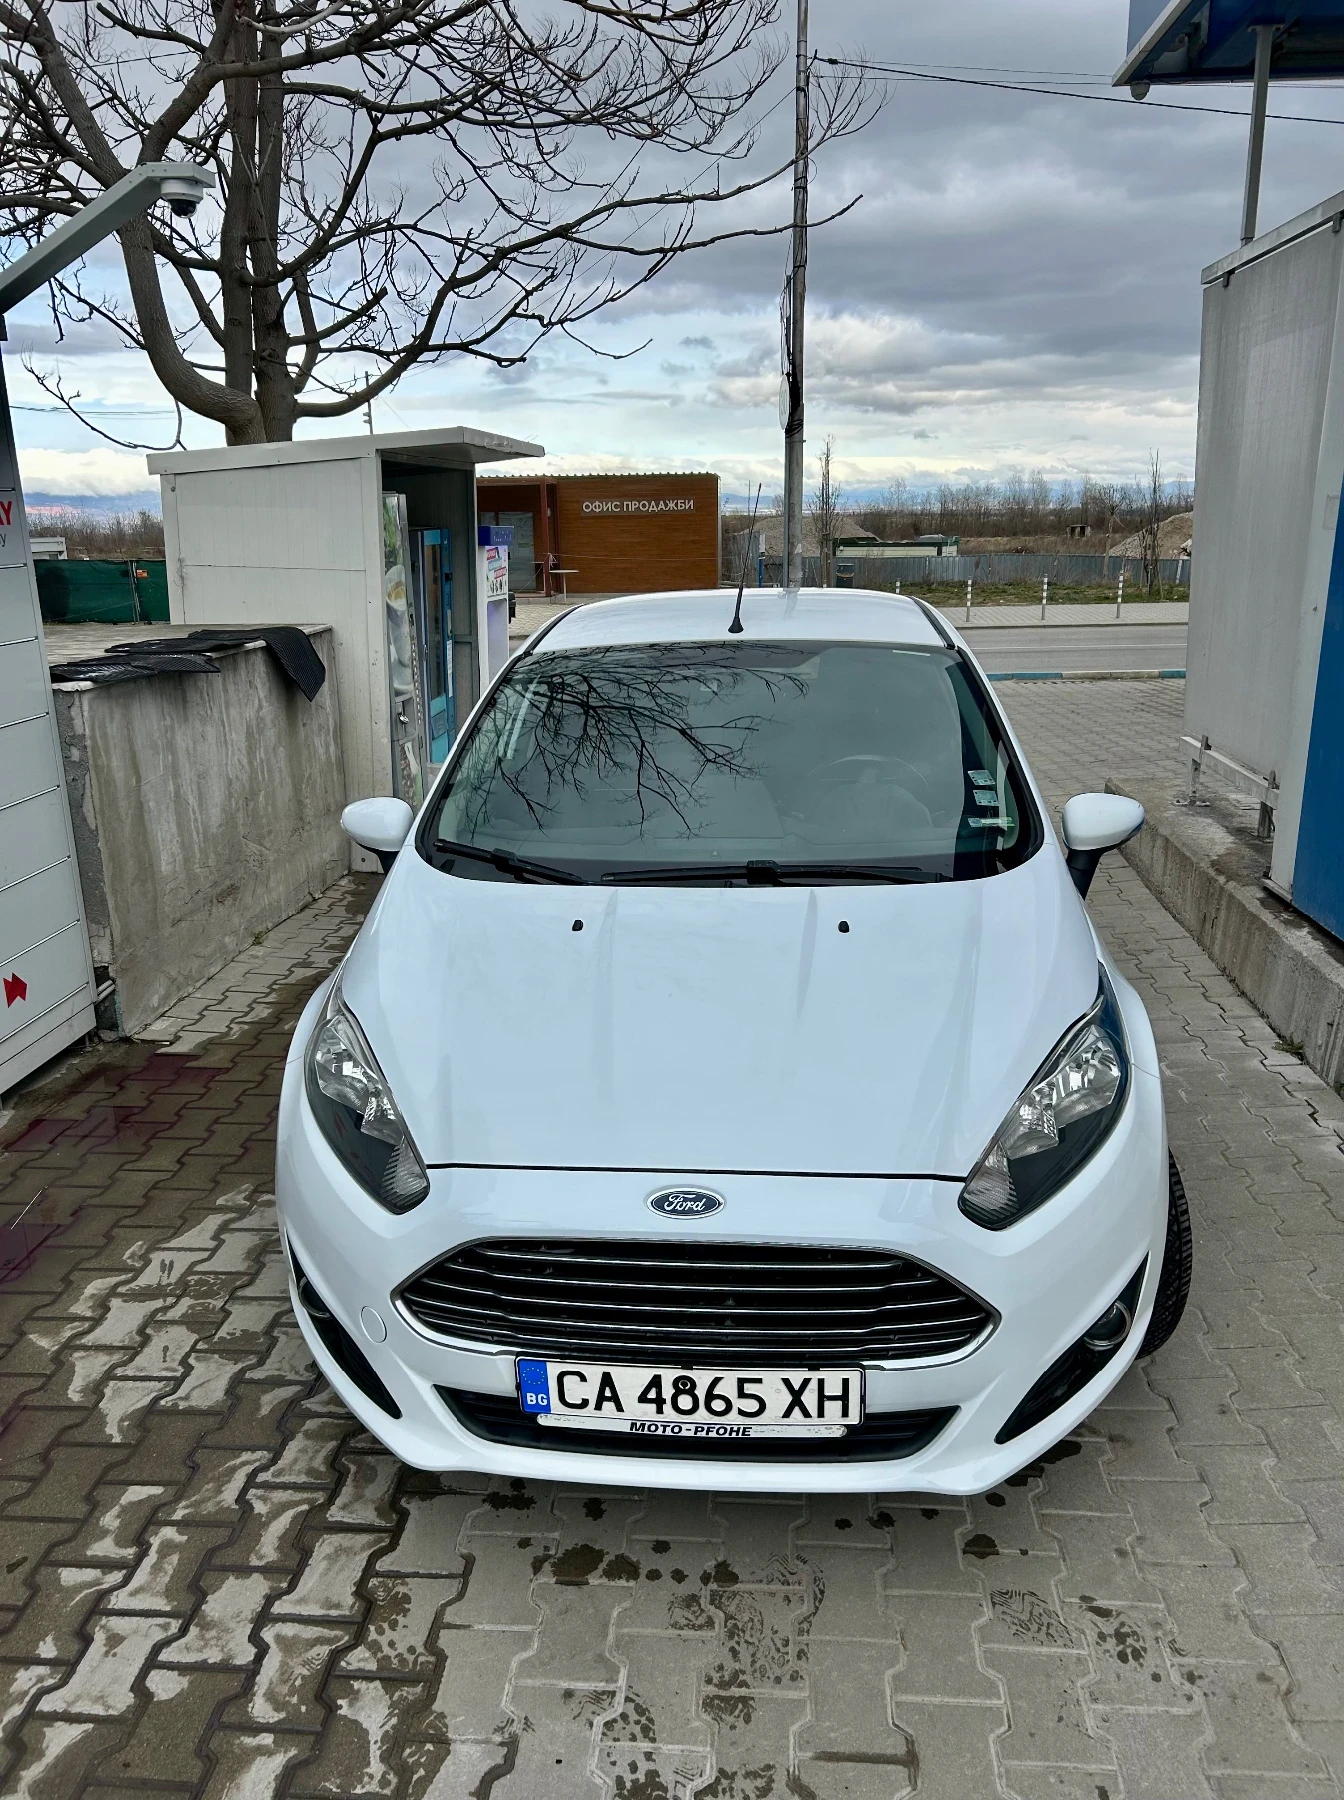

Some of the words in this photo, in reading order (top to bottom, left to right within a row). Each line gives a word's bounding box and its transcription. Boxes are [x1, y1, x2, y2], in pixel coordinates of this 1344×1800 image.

[582, 501, 621, 513] ОФИС
[623, 499, 694, 513] ПРОДАЖБИ
[664, 1193, 707, 1211] Ford
[526, 1392, 548, 1406] BG
[556, 1370, 625, 1413] CA
[637, 1373, 767, 1419] 4865
[780, 1376, 850, 1419] XH
